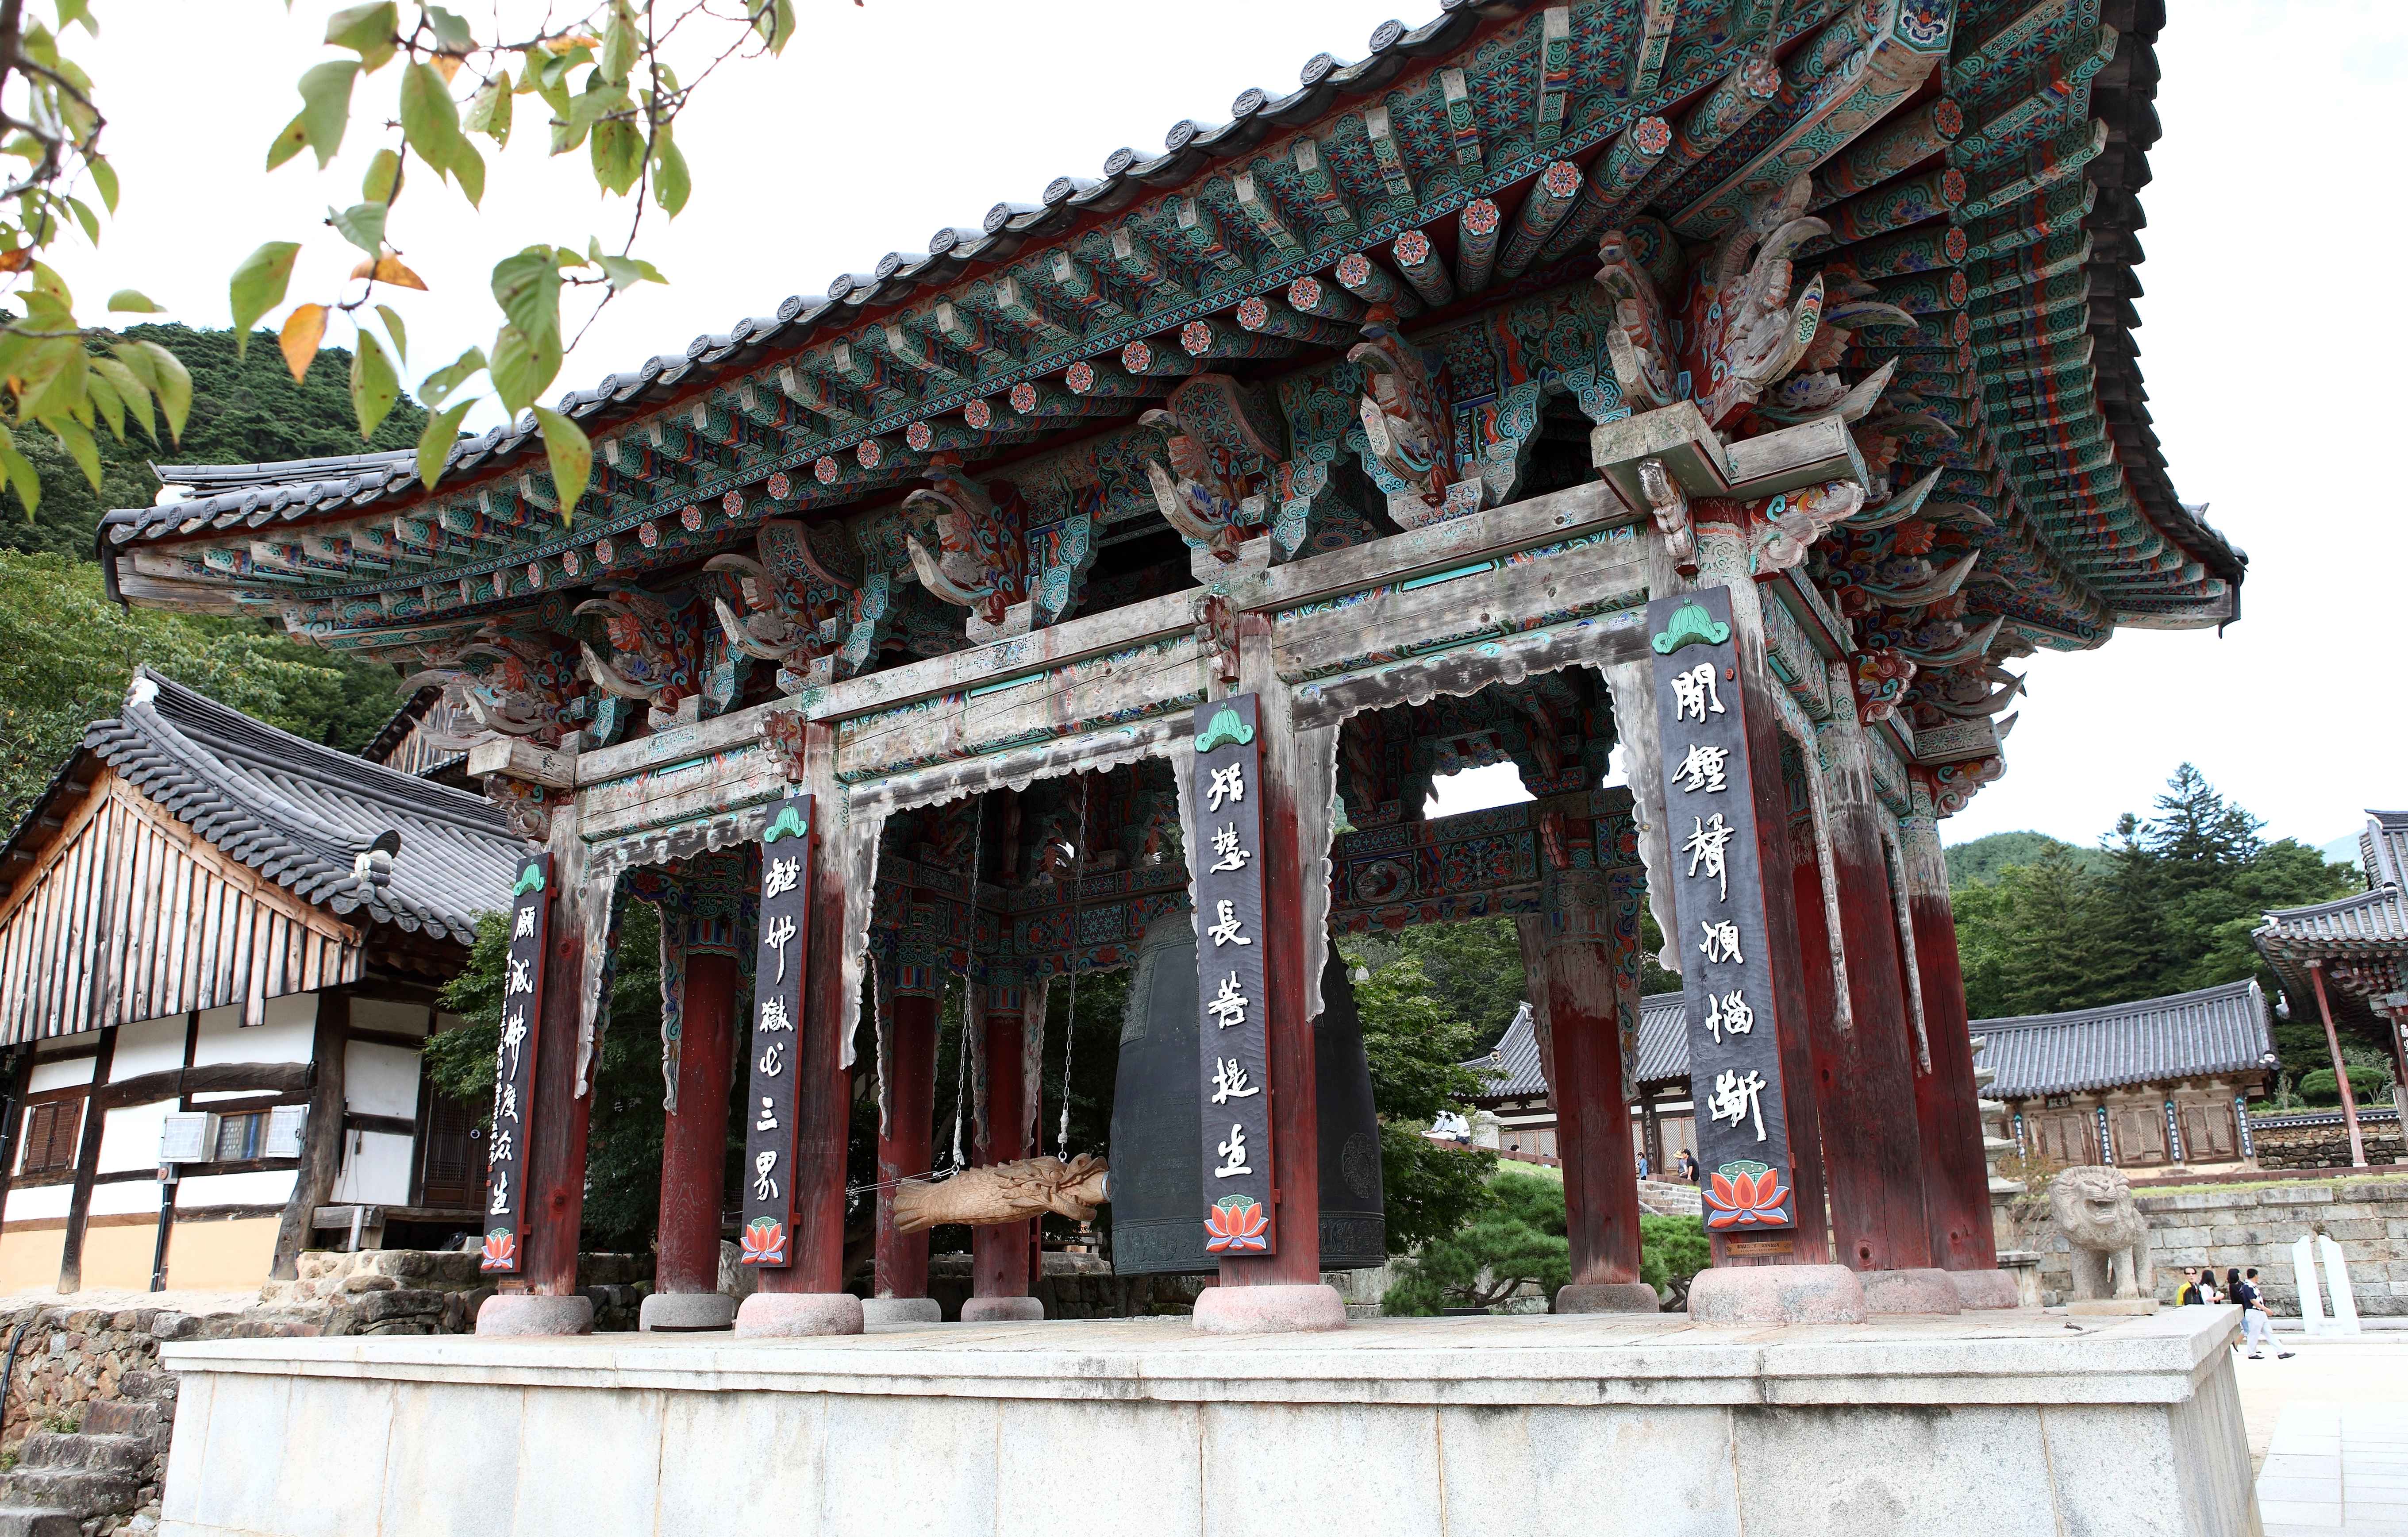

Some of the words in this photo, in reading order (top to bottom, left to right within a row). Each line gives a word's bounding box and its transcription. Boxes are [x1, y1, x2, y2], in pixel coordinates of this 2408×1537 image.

[1207, 762, 1259, 1178] 智慧長菩提生
